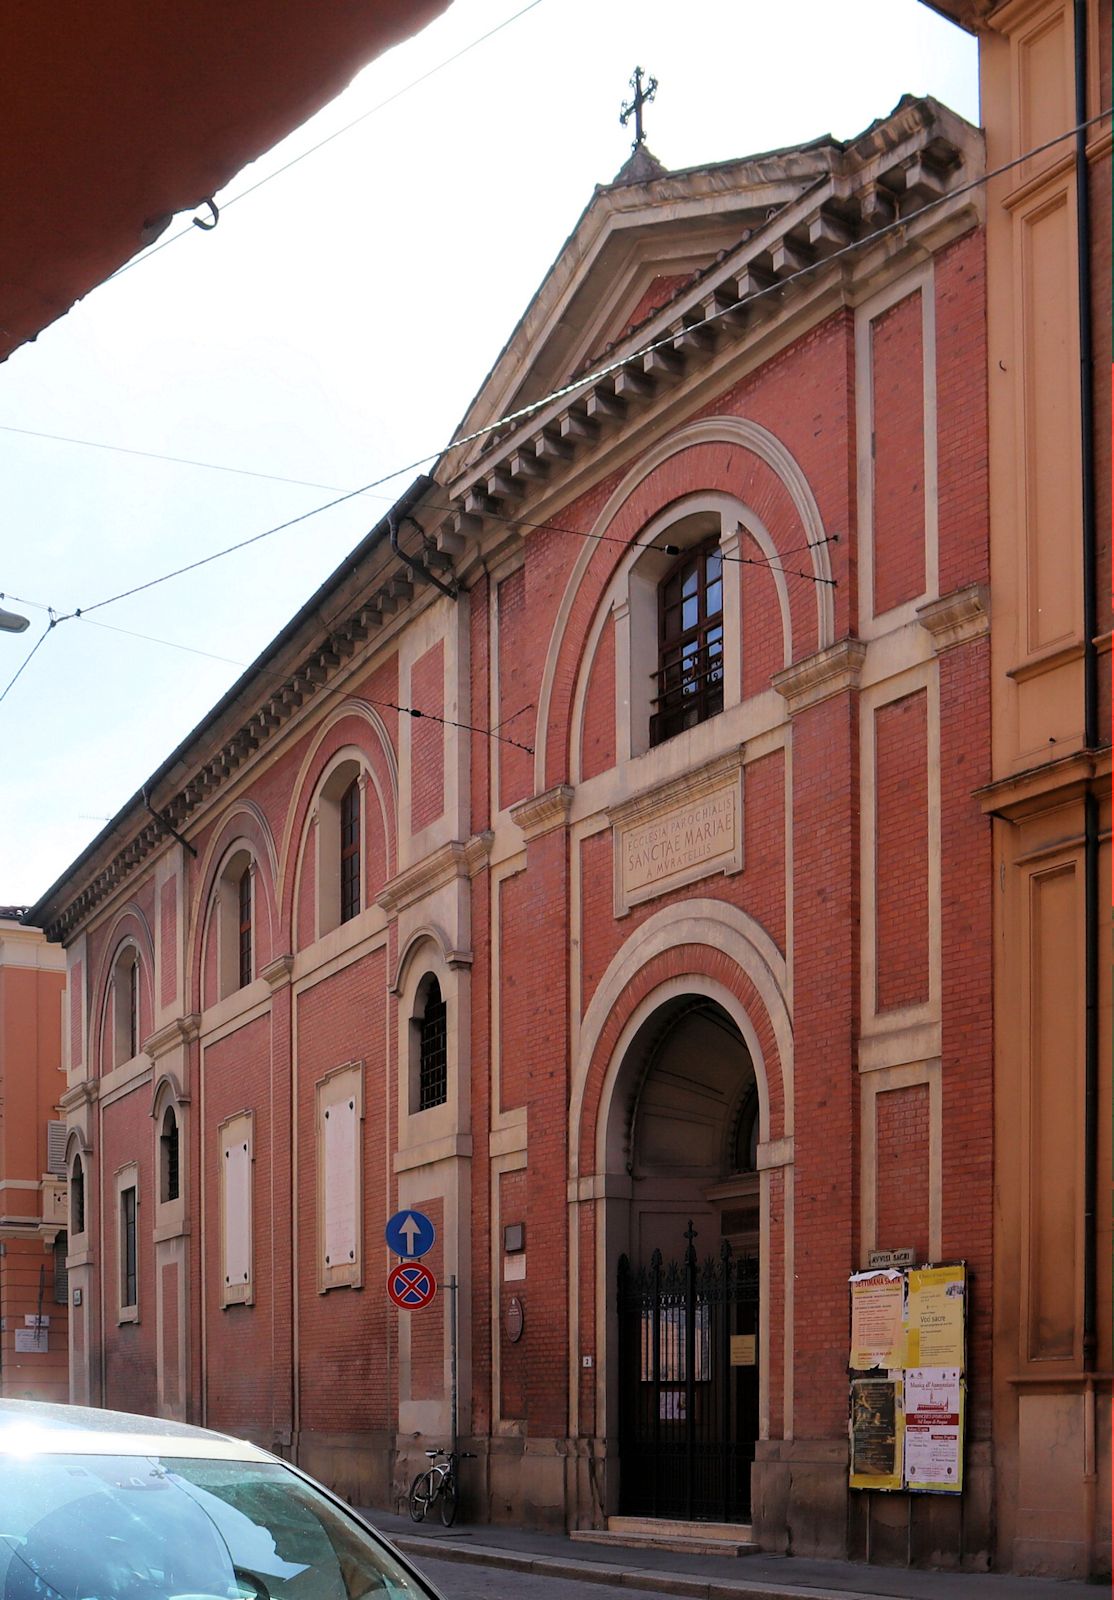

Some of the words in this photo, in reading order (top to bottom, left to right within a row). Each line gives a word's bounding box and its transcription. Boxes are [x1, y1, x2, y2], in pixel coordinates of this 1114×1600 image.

[628, 828, 667, 852] ECCLESIA
[671, 798, 731, 832] PAROCHIALIS
[629, 835, 681, 871] SANCTAE
[684, 814, 732, 845] MARIAE
[646, 870, 653, 879] A
[656, 844, 711, 872] MVRATELLIS
[872, 1255, 891, 1263] AVVISI
[893, 1253, 910, 1261] SACRI
